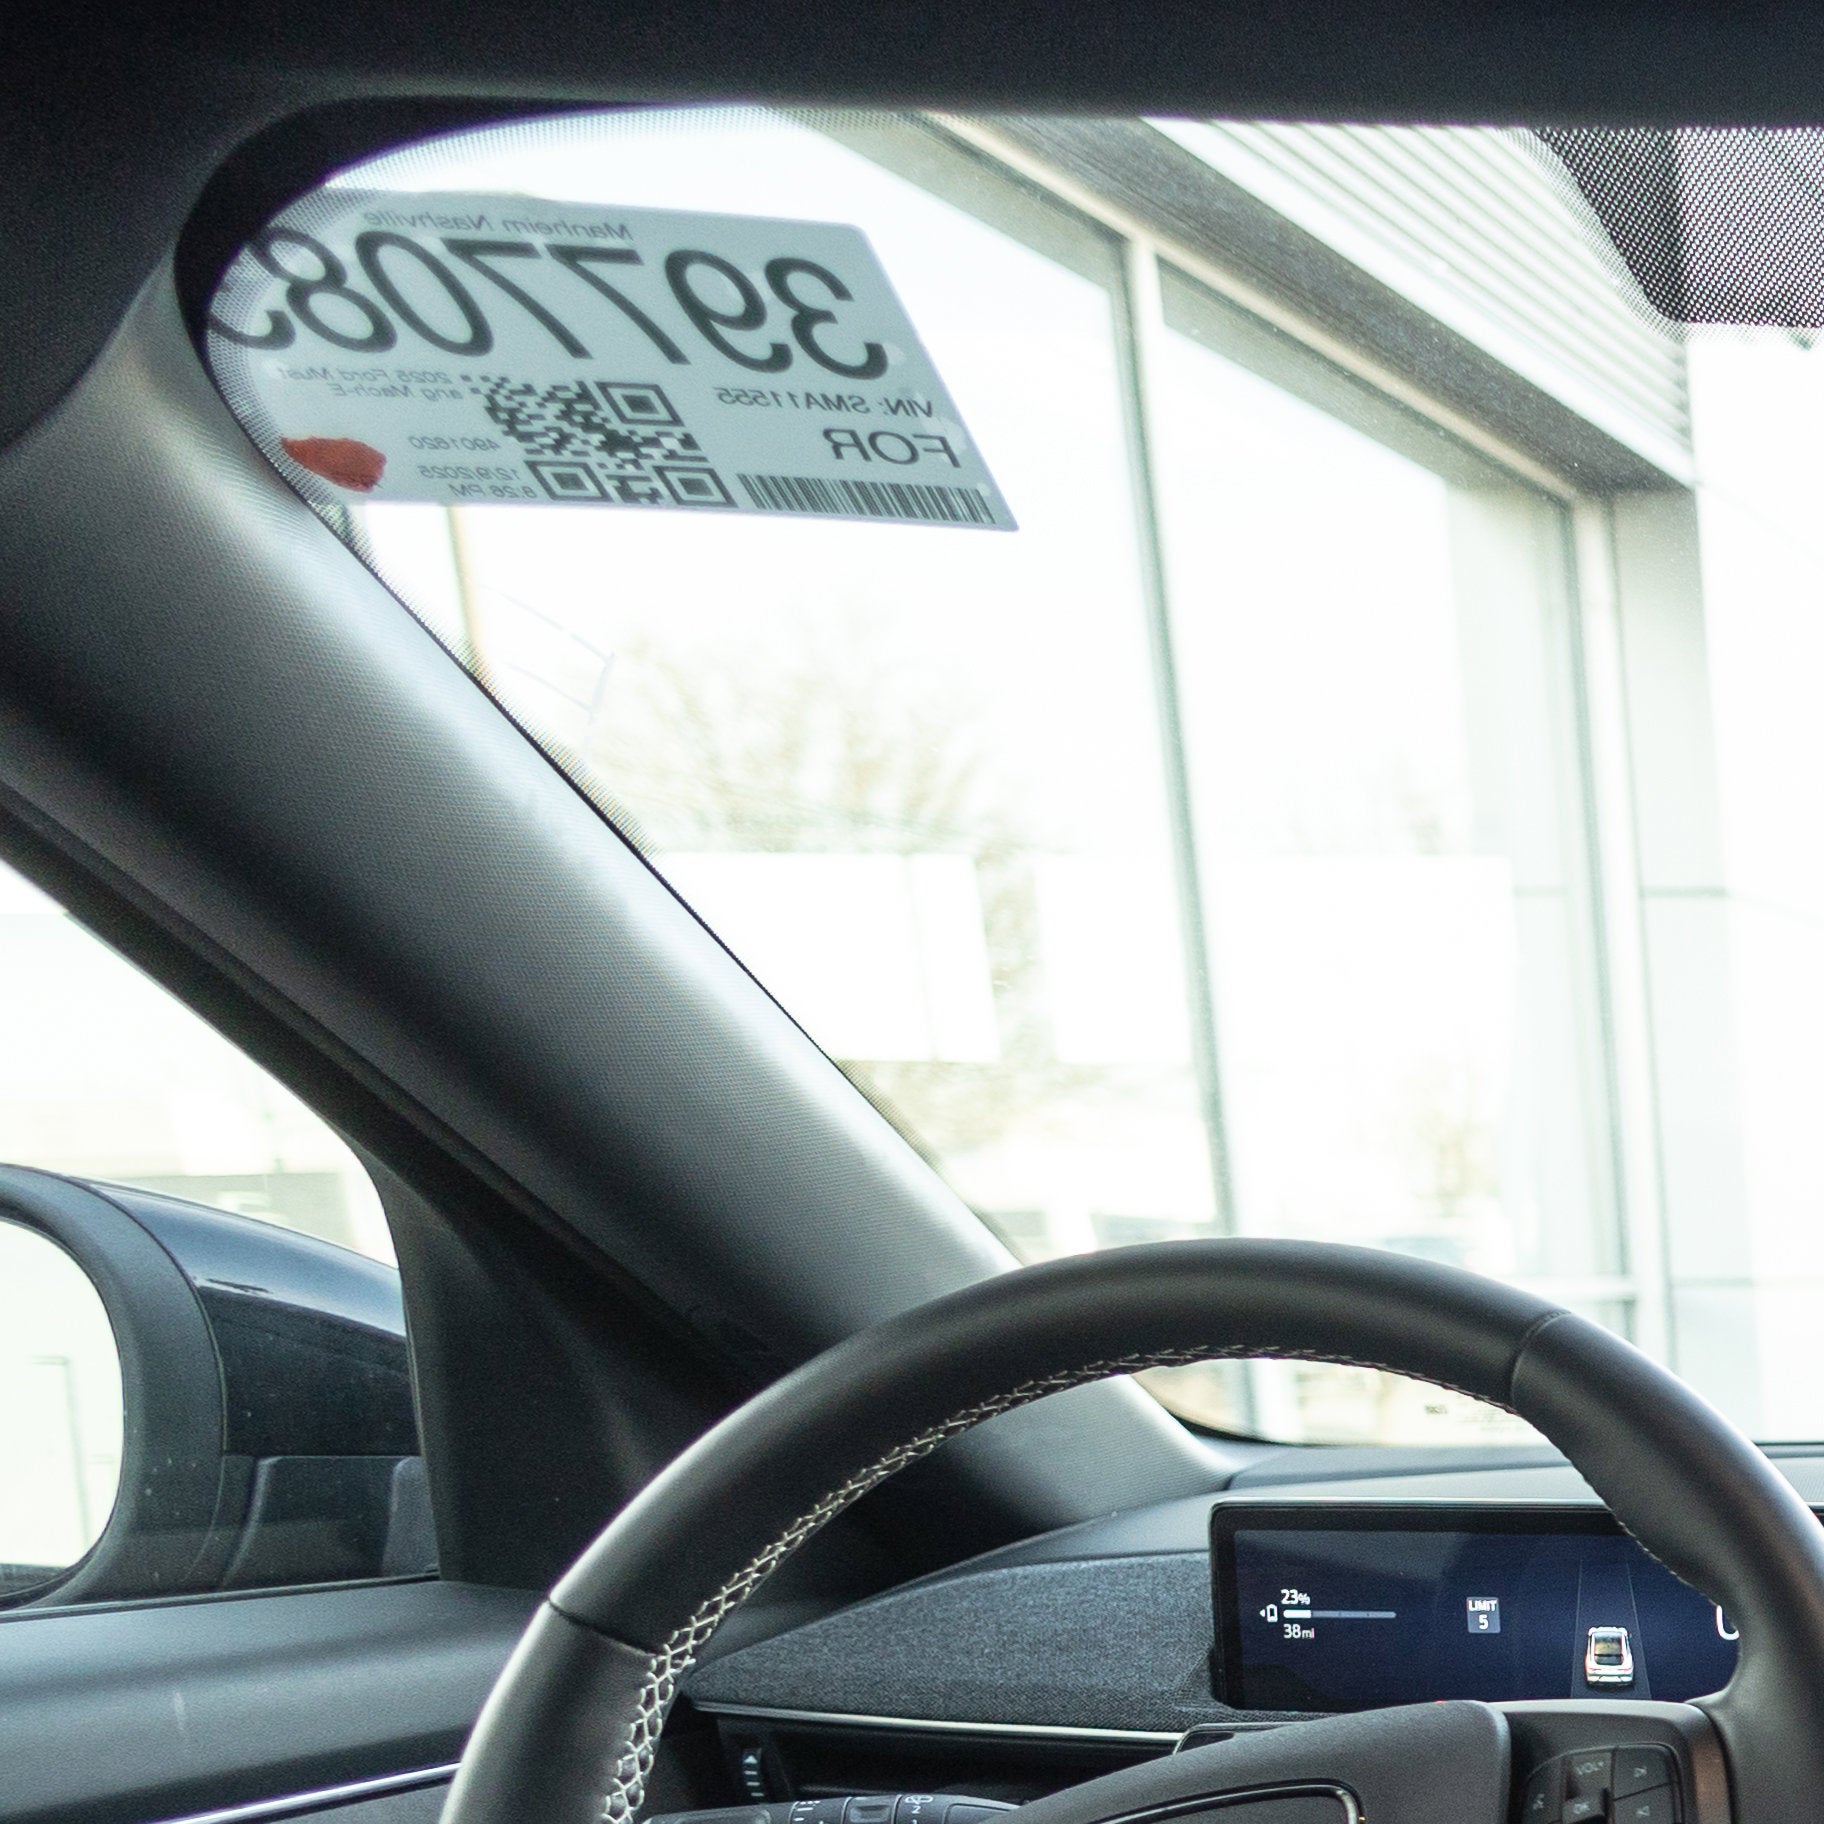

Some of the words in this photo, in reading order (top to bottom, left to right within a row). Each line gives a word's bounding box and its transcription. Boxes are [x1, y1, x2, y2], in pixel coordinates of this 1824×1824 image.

[1280, 1589, 1311, 1605] 23%
[1468, 1600, 1498, 1612] LIMIT
[1478, 1615, 1489, 1630] 5
